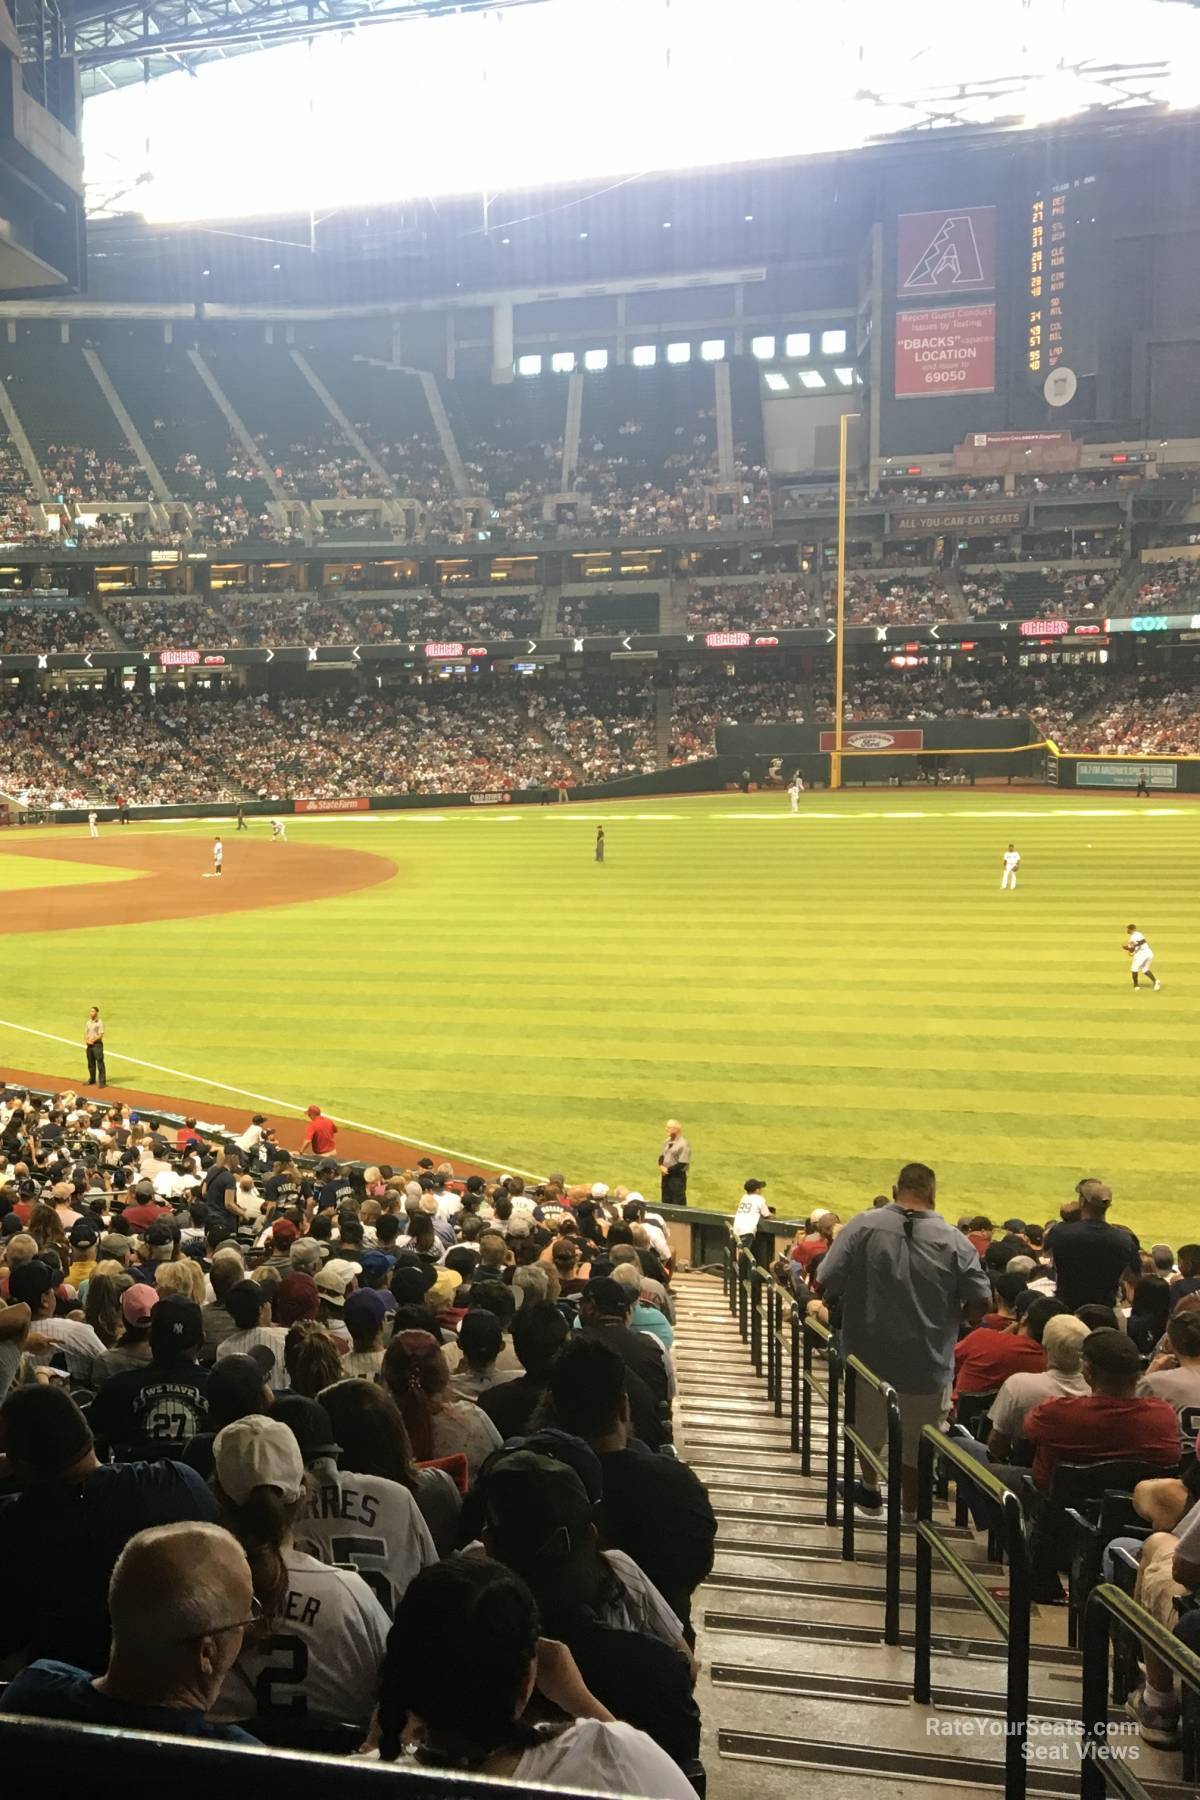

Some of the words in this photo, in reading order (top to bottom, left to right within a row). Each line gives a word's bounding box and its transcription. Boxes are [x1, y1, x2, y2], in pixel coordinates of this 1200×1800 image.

[914, 348, 977, 362] LOCATION
[925, 370, 966, 383] 69050
[900, 515, 985, 528] ALL-YOU-CAN-EAT
[989, 513, 1020, 524] SEATS
[1131, 616, 1168, 630] COX
[145, 1385, 163, 1396] WE
[166, 1384, 196, 1397] HAVE
[152, 1412, 188, 1441] 27
[255, 1633, 309, 1718] 2
